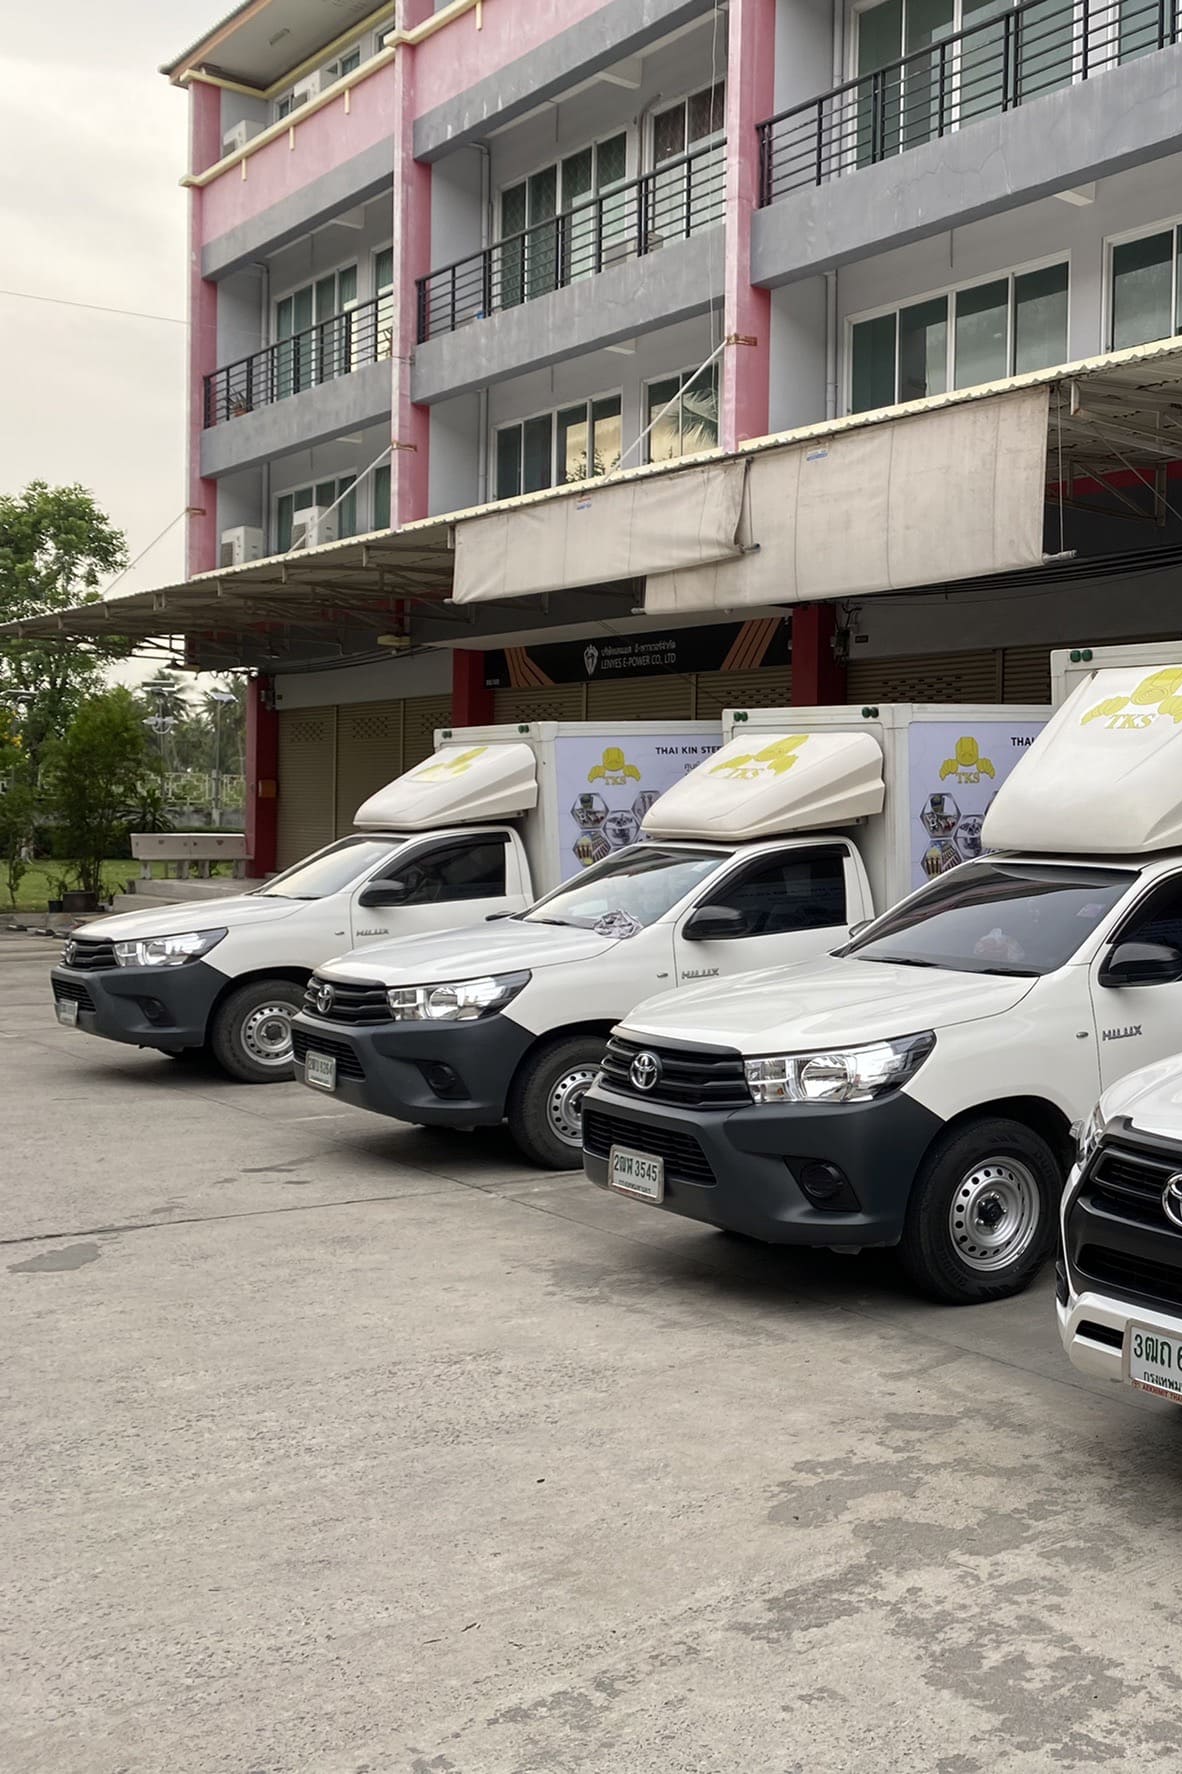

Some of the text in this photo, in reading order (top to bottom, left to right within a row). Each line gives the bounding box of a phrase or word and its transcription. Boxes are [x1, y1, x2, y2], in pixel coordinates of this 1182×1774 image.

[1104, 713, 1156, 730] TKS
[1010, 736, 1035, 747] THAI
[655, 746, 679, 755] THAI
[681, 746, 698, 754] KIN
[604, 775, 627, 786] TKS
[956, 772, 981, 785] TKS
[681, 968, 720, 980] HILUX
[1102, 1024, 1142, 1042] HILUX
[634, 1159, 658, 1182] 3545
